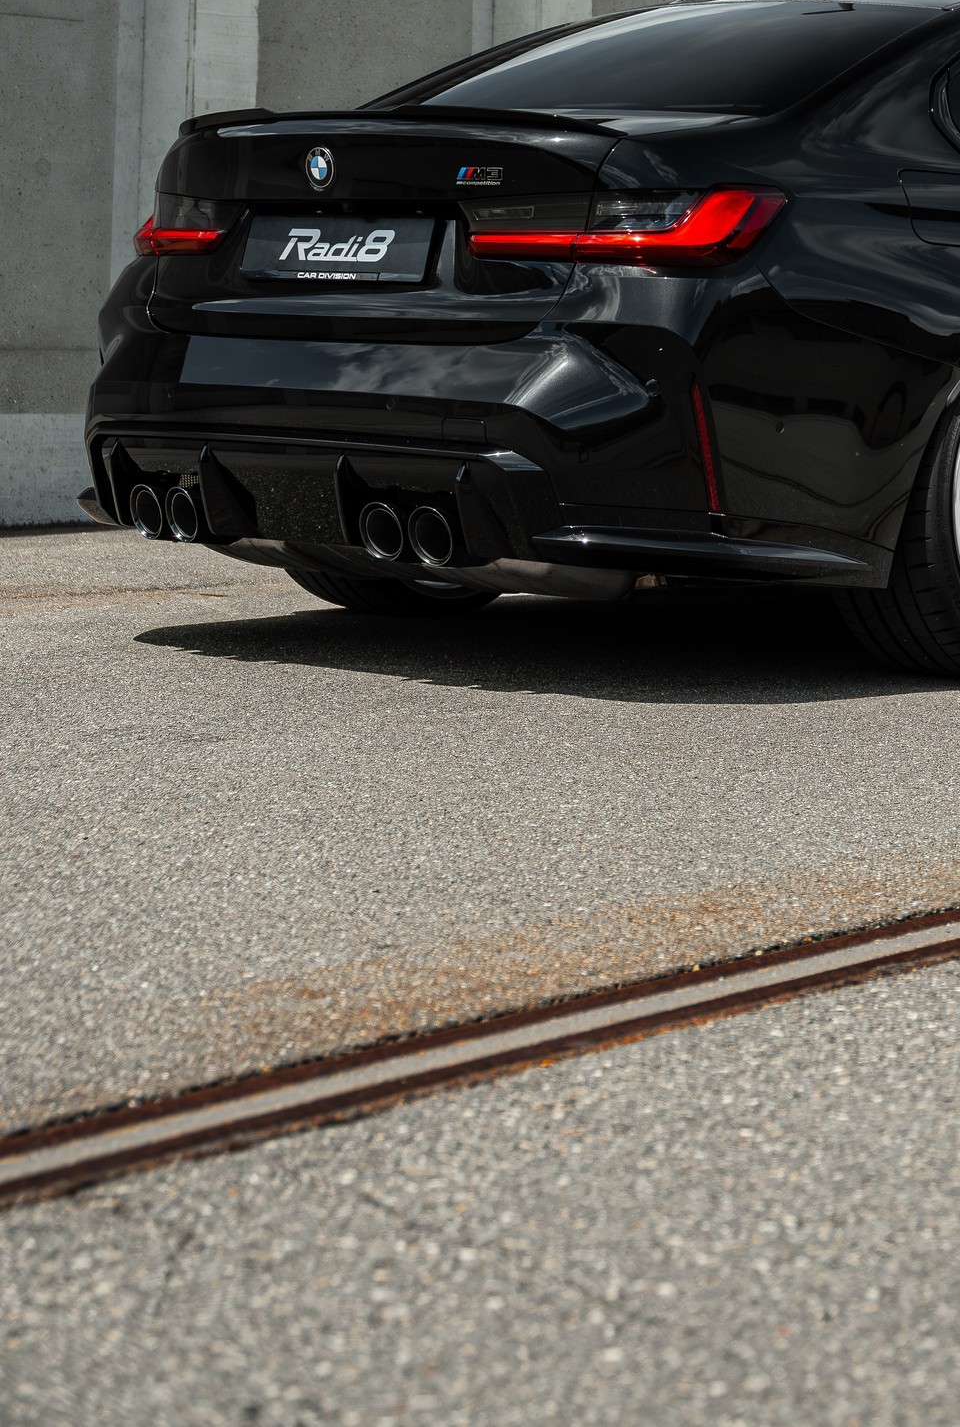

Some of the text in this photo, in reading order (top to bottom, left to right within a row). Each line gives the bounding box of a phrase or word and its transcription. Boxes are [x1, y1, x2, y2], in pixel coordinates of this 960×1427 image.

[308, 149, 330, 162] BMW
[471, 167, 503, 180] M3
[278, 228, 396, 262] Radi8
